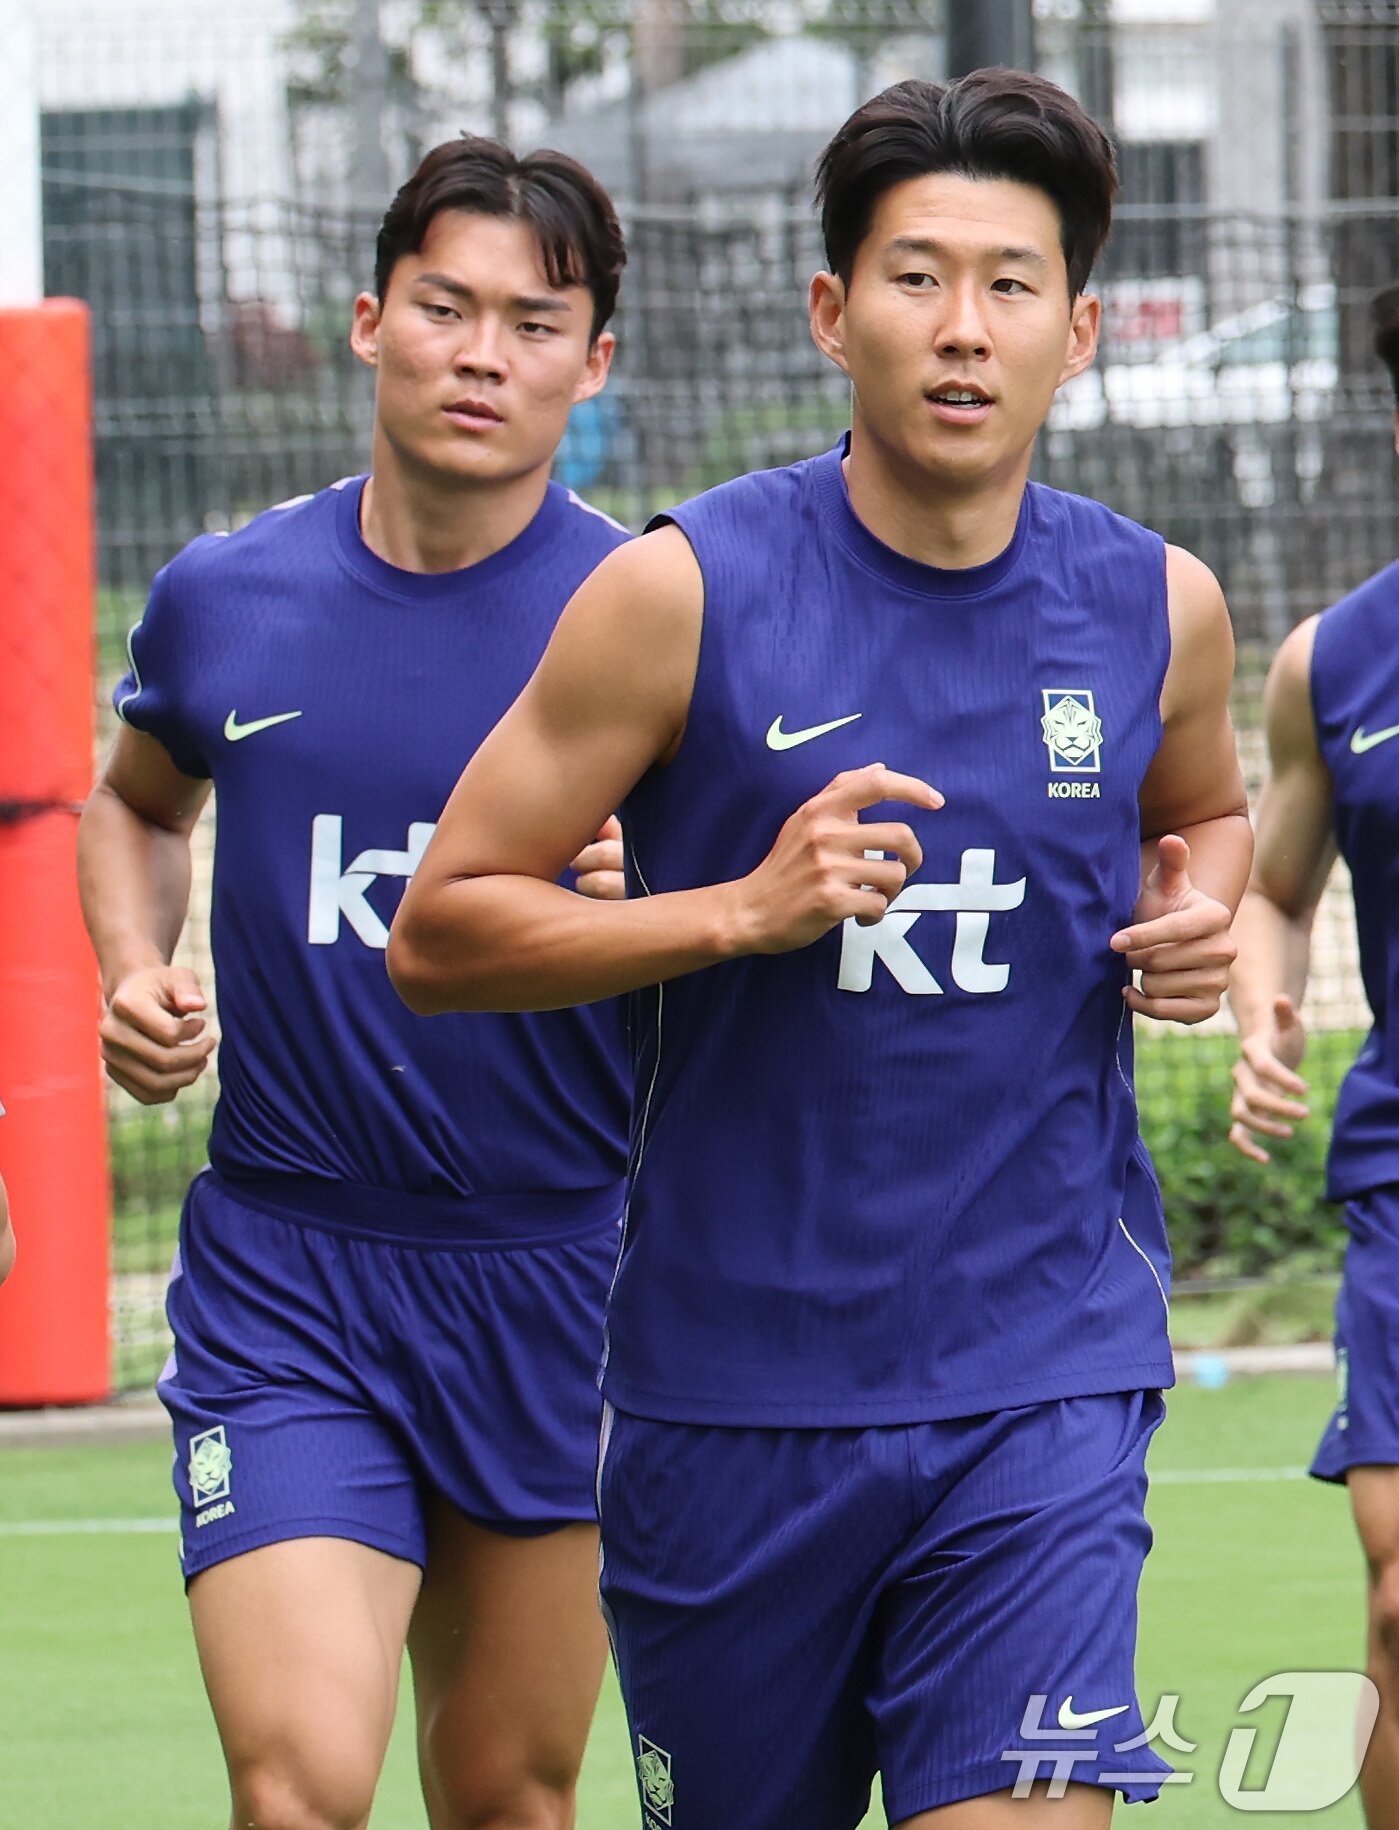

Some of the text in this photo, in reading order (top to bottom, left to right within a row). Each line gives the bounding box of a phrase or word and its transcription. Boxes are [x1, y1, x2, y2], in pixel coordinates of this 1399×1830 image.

[1048, 782, 1100, 798] KOREA
[837, 848, 1026, 994] kt
[196, 1501, 235, 1528] KOREA
